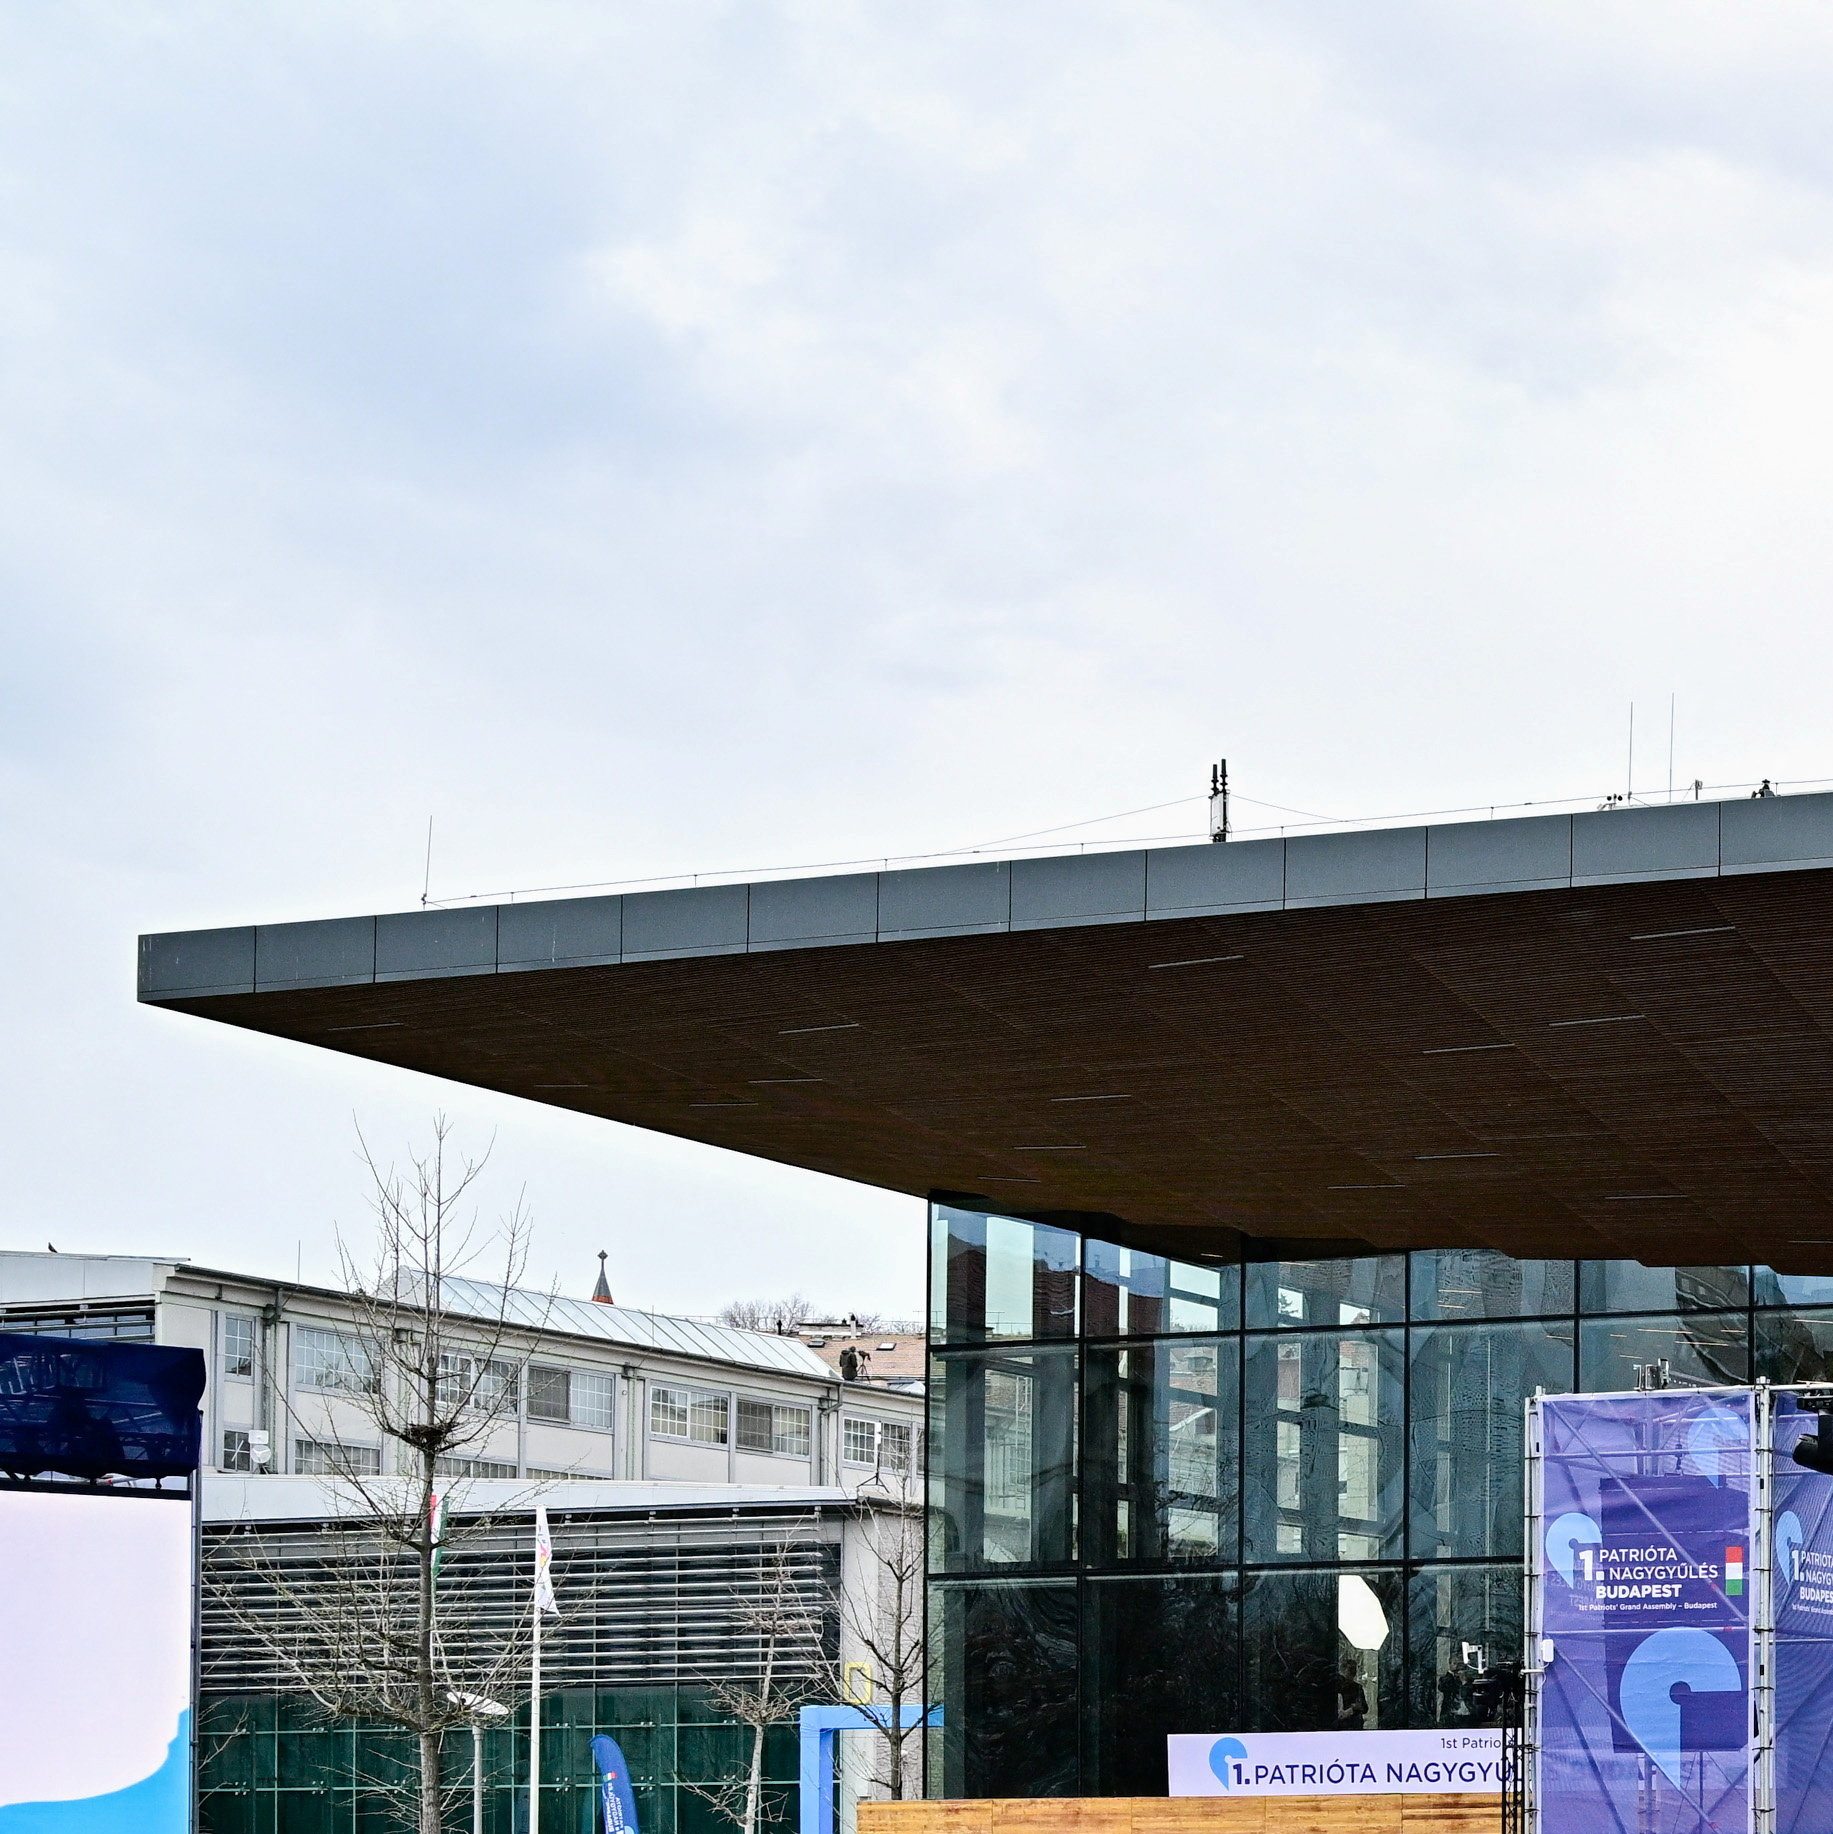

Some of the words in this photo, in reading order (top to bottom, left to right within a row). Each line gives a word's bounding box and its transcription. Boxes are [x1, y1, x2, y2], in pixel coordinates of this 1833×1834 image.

[1579, 1550, 1605, 1581] 1.
[1600, 1545, 1678, 1562] PATRIÓTA
[1609, 1562, 1719, 1581] NAGYGYŰLÉS
[1791, 1550, 1805, 1581] 1.
[1595, 1584, 1682, 1599] BUDAPEST
[1620, 1603, 1641, 1611] Grand
[1642, 1602, 1677, 1611] Assembly
[1684, 1602, 1717, 1610] Budapest
[1441, 1738, 1458, 1749] 1st
[1462, 1737, 1502, 1749] Patrio
[1232, 1764, 1250, 1785] 1.
[1255, 1759, 1376, 1785] PATRIÓTA
